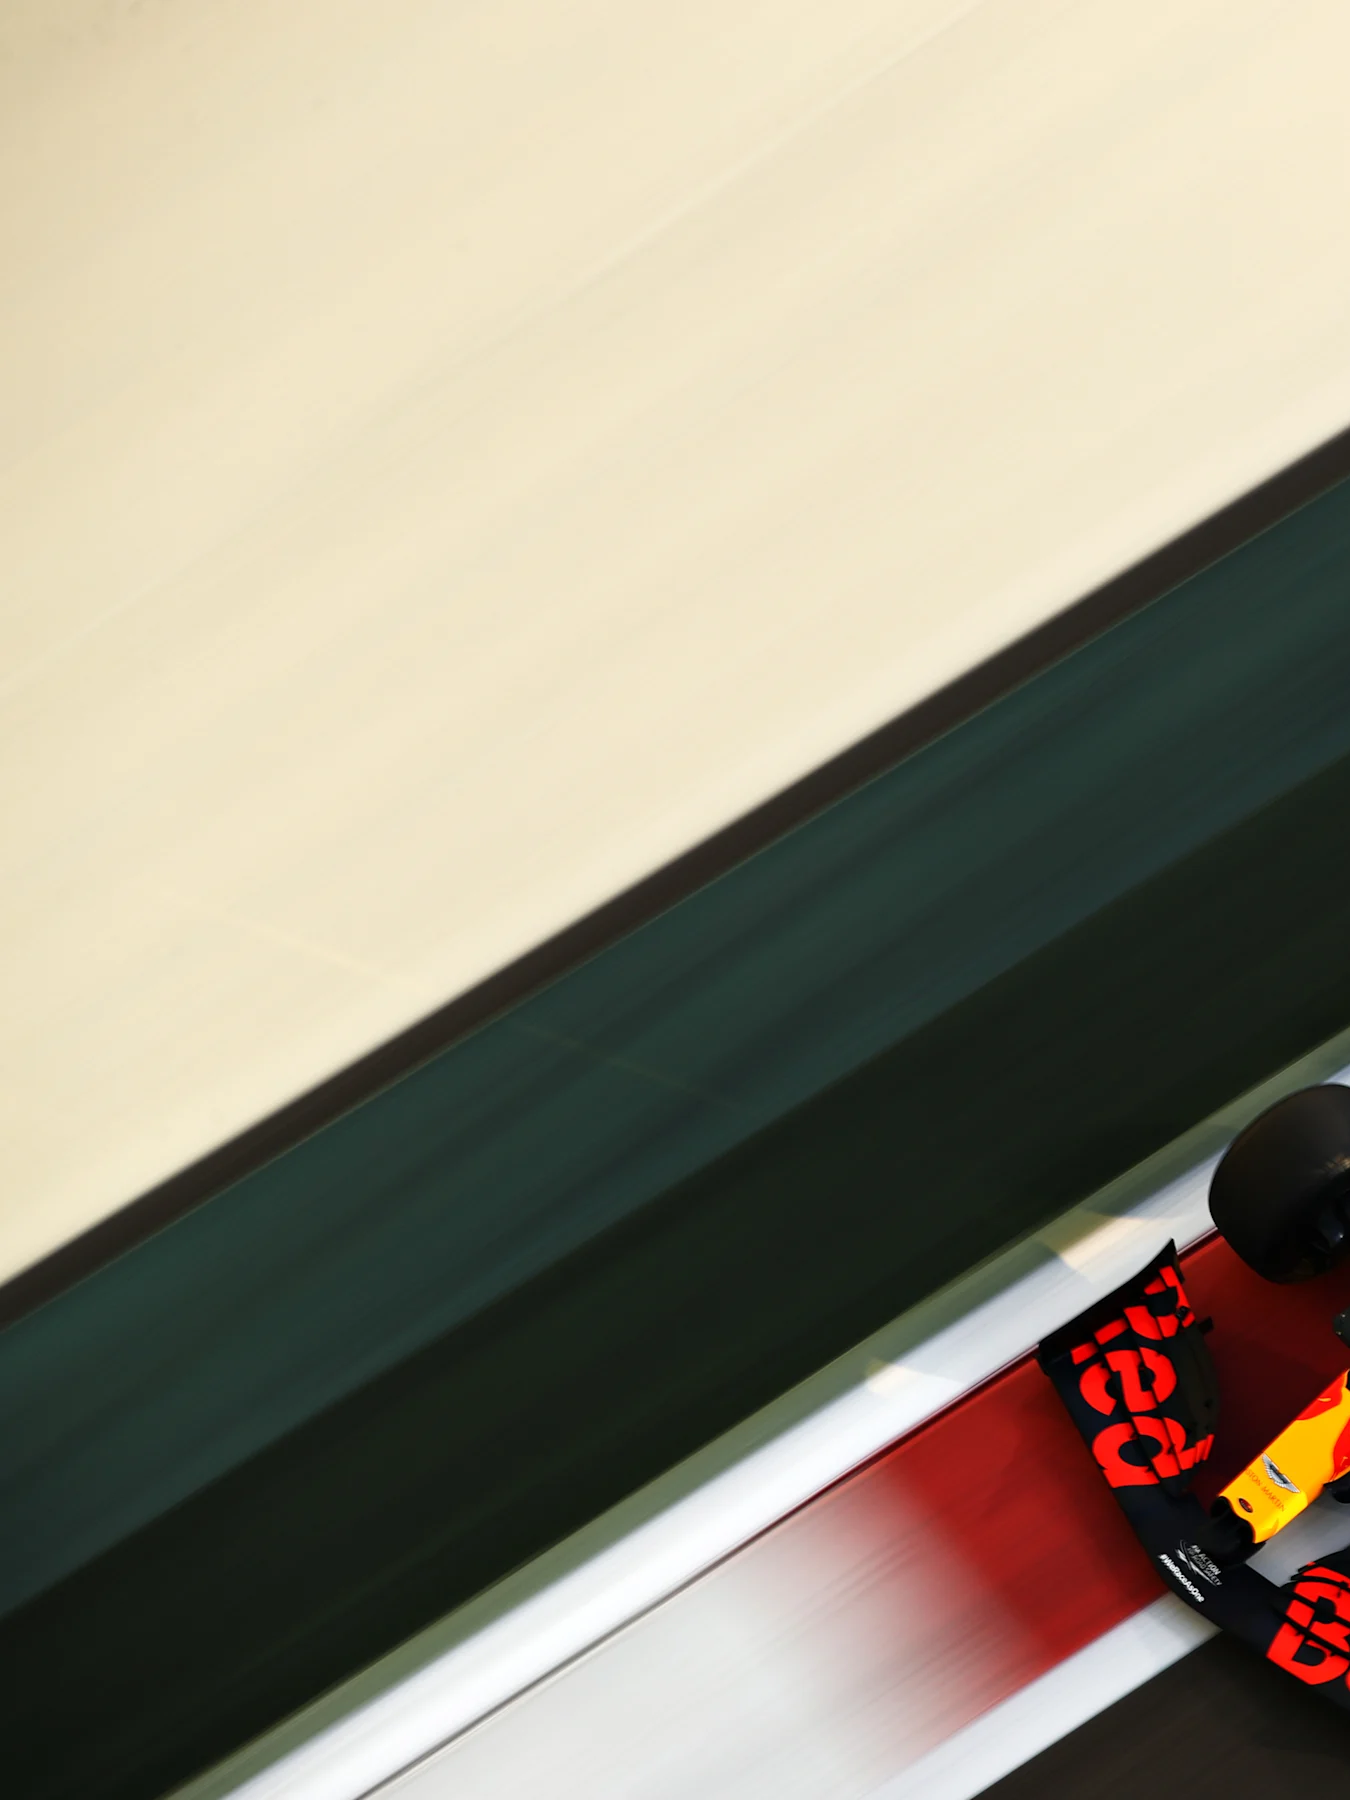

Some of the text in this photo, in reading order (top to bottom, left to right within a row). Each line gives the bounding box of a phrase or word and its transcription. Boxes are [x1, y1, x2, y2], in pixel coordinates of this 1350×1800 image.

[1199, 1553, 1222, 1576] ACTION
[1158, 1553, 1205, 1603] #WeRaceAsOne
[1204, 1567, 1223, 1587] SAFETY
